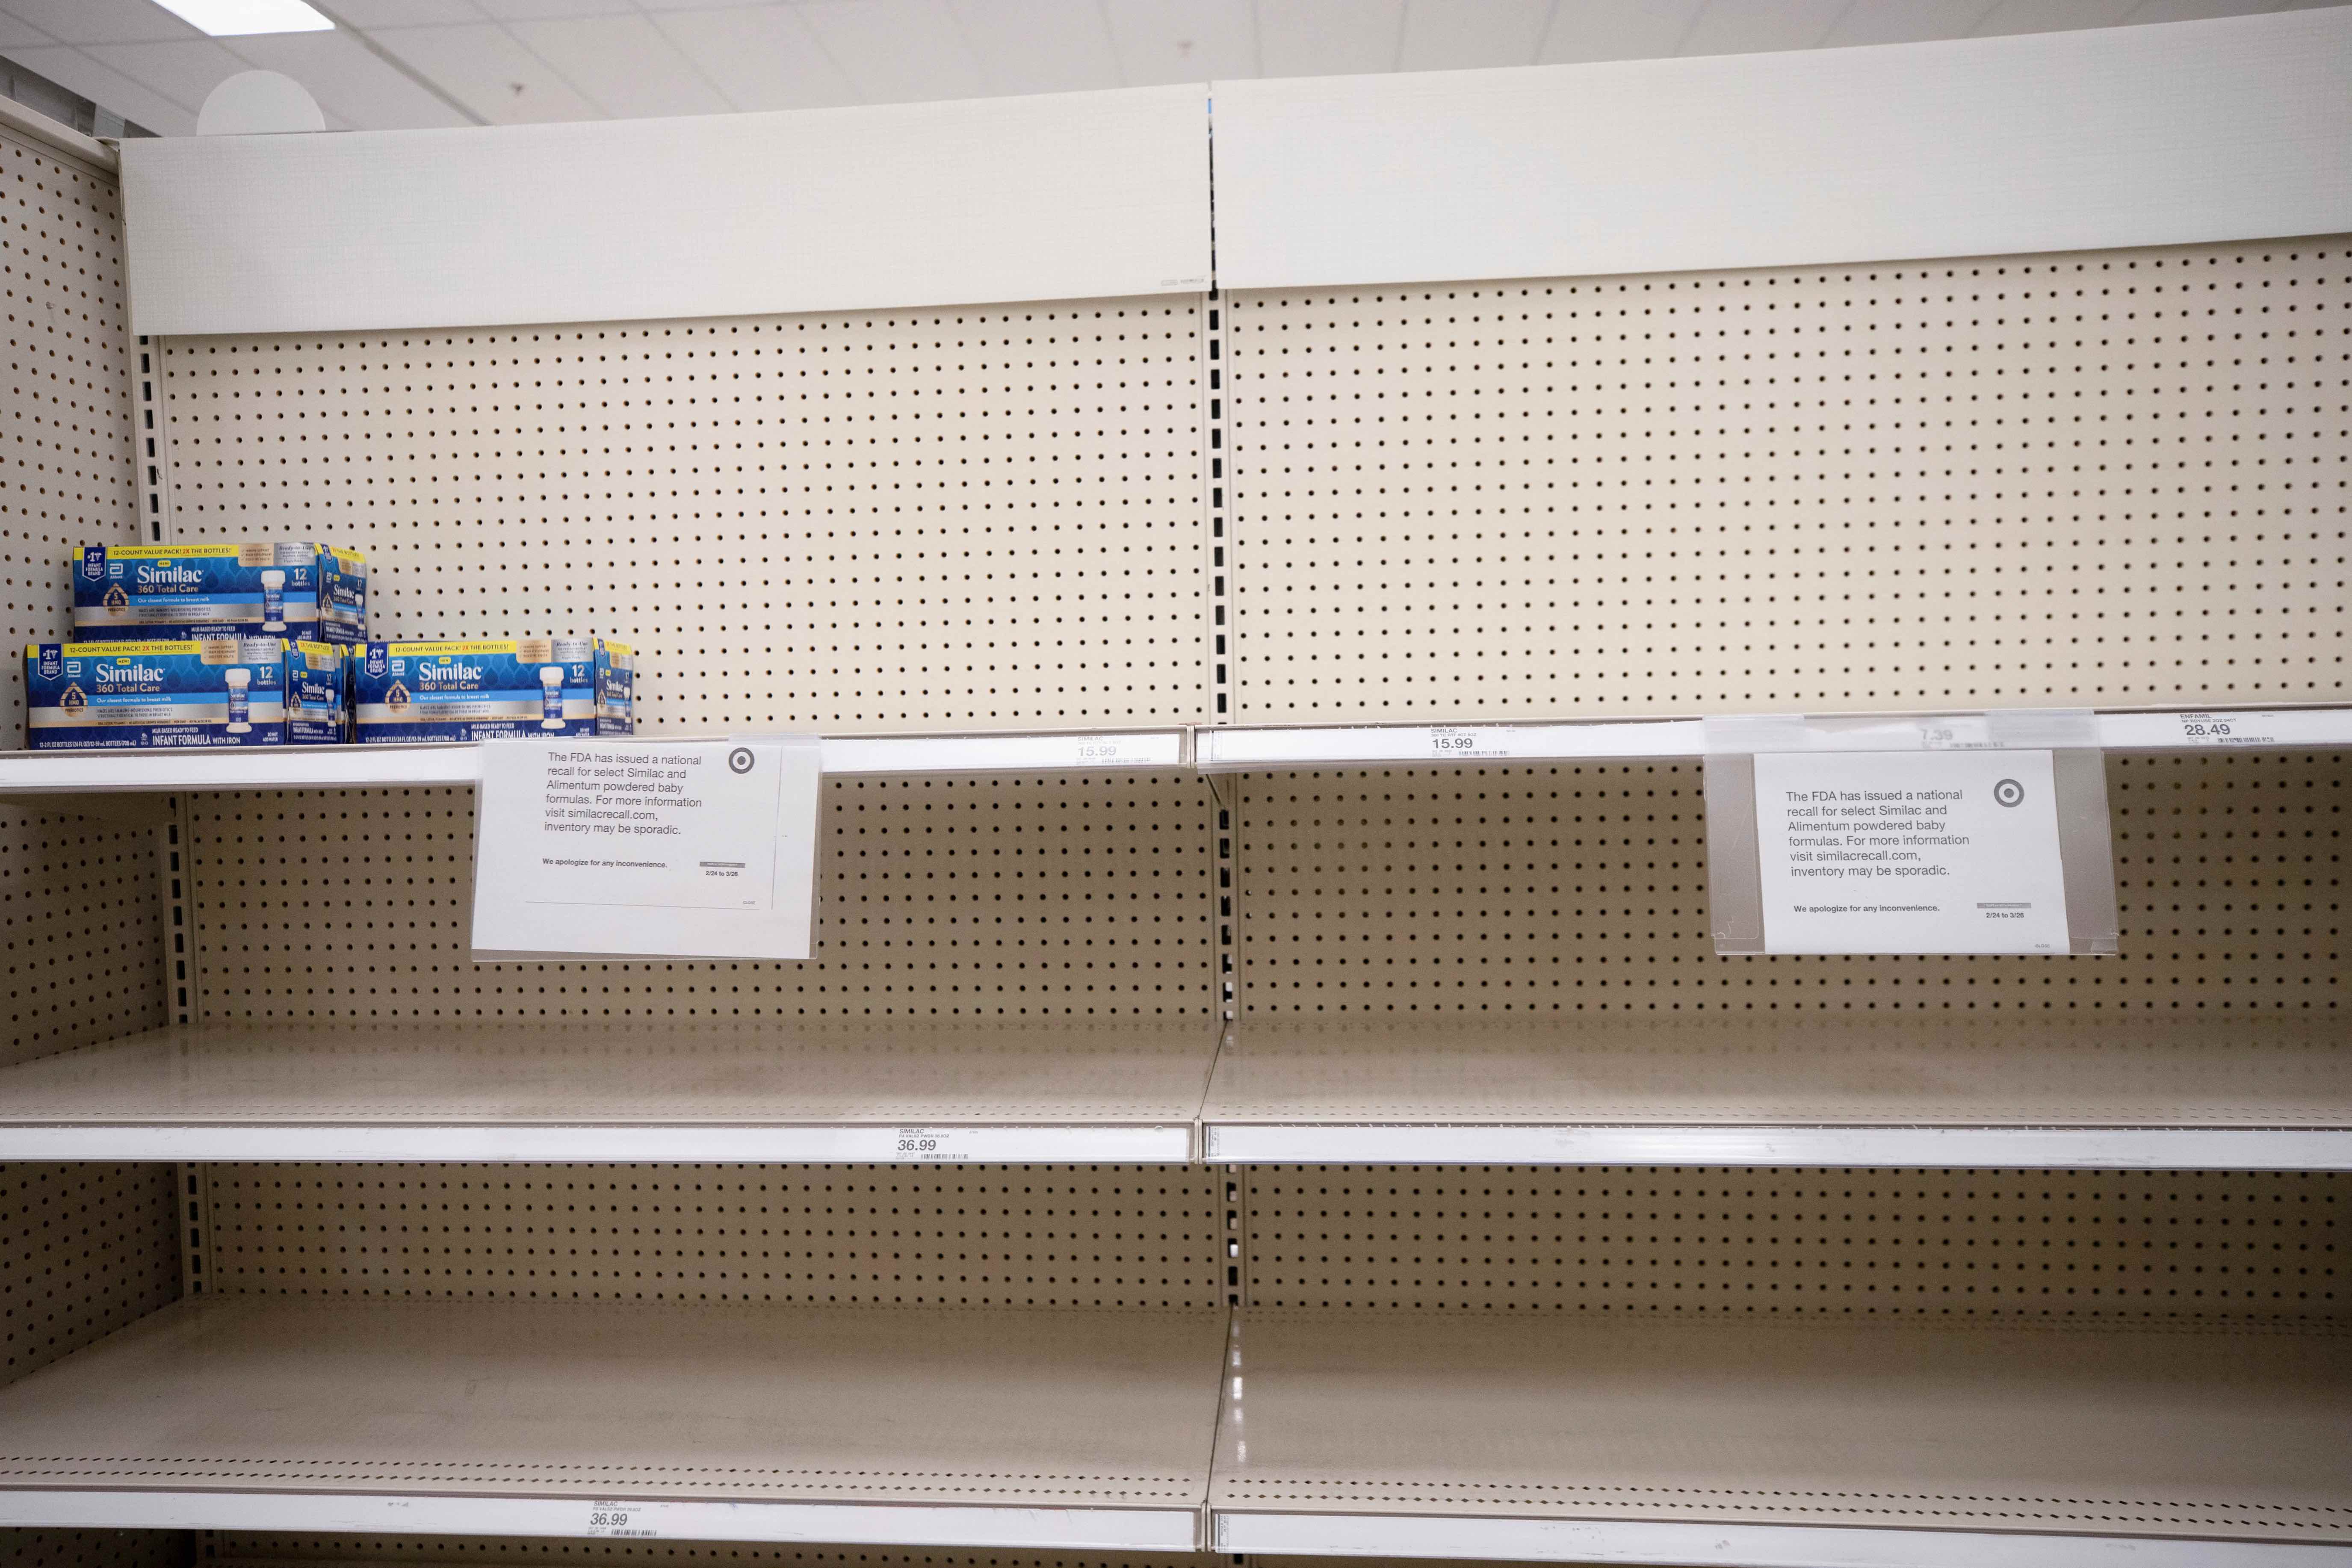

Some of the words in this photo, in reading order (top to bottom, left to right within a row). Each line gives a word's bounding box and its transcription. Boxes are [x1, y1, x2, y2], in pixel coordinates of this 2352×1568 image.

[137, 565, 202, 583] Similac
[294, 568, 307, 580] 12
[179, 585, 198, 593] Care
[96, 664, 163, 682] Similac
[260, 666, 273, 679] 12
[419, 662, 482, 680] Similac
[572, 665, 585, 676] 12
[116, 684, 137, 692] Total
[140, 683, 160, 691] Care
[420, 682, 435, 690] 360
[439, 682, 457, 690] Total
[460, 681, 478, 689] Care
[2184, 723, 2231, 735] 28.49
[153, 735, 177, 745] INFANT
[179, 735, 211, 745] FORMULA
[1433, 738, 1473, 748] 15.99
[1078, 746, 1117, 756] 15.99
[548, 752, 567, 762] The
[570, 753, 592, 762] FDA
[595, 753, 613, 763] has
[616, 753, 649, 764] issued
[661, 755, 701, 765] national
[547, 766, 574, 776] recall
[578, 766, 592, 776] for
[594, 768, 624, 777] select
[627, 768, 664, 778] Similac
[667, 769, 686, 779] and
[546, 780, 600, 790] Alimentum
[603, 782, 655, 792] powdered
[658, 783, 684, 795] baby
[546, 794, 592, 804] formulas.
[596, 795, 613, 805] For
[615, 797, 641, 806] more
[645, 796, 702, 807] information
[1785, 791, 1808, 802] The
[1812, 791, 1837, 801] FDA
[1840, 791, 1861, 801] has
[1864, 790, 1902, 800] issued
[1906, 792, 1913, 800] a
[1916, 789, 1962, 800] national
[545, 808, 565, 818] visit
[568, 809, 658, 821] similacrecall.com,
[1787, 806, 1818, 817] recall
[1821, 806, 1838, 816] for
[1841, 806, 1876, 816] select
[1879, 805, 1921, 815] Similac
[1925, 805, 1947, 815] and
[544, 821, 591, 834] inventory
[594, 825, 615, 835] may
[618, 824, 631, 833] be
[634, 825, 681, 836] sporadic.
[1788, 821, 1850, 831] Alimentum
[1854, 820, 1913, 833] powdered
[1916, 820, 1945, 832] baby
[1789, 836, 1843, 846] formulas.
[1847, 836, 1866, 845] For
[1903, 834, 1969, 845] information
[1790, 851, 1813, 861] visit
[1817, 850, 1921, 862] similacrecall.com,
[555, 859, 589, 867] apologize
[616, 860, 668, 868] inconvenience.
[1791, 866, 1844, 879] inventory
[1848, 868, 1873, 878] may
[1876, 865, 1891, 876] be
[1895, 865, 1950, 878] sporadic.
[1809, 905, 1848, 913] apologize
[898, 1140, 937, 1151] 36.99
[590, 1513, 627, 1526] 36.99
